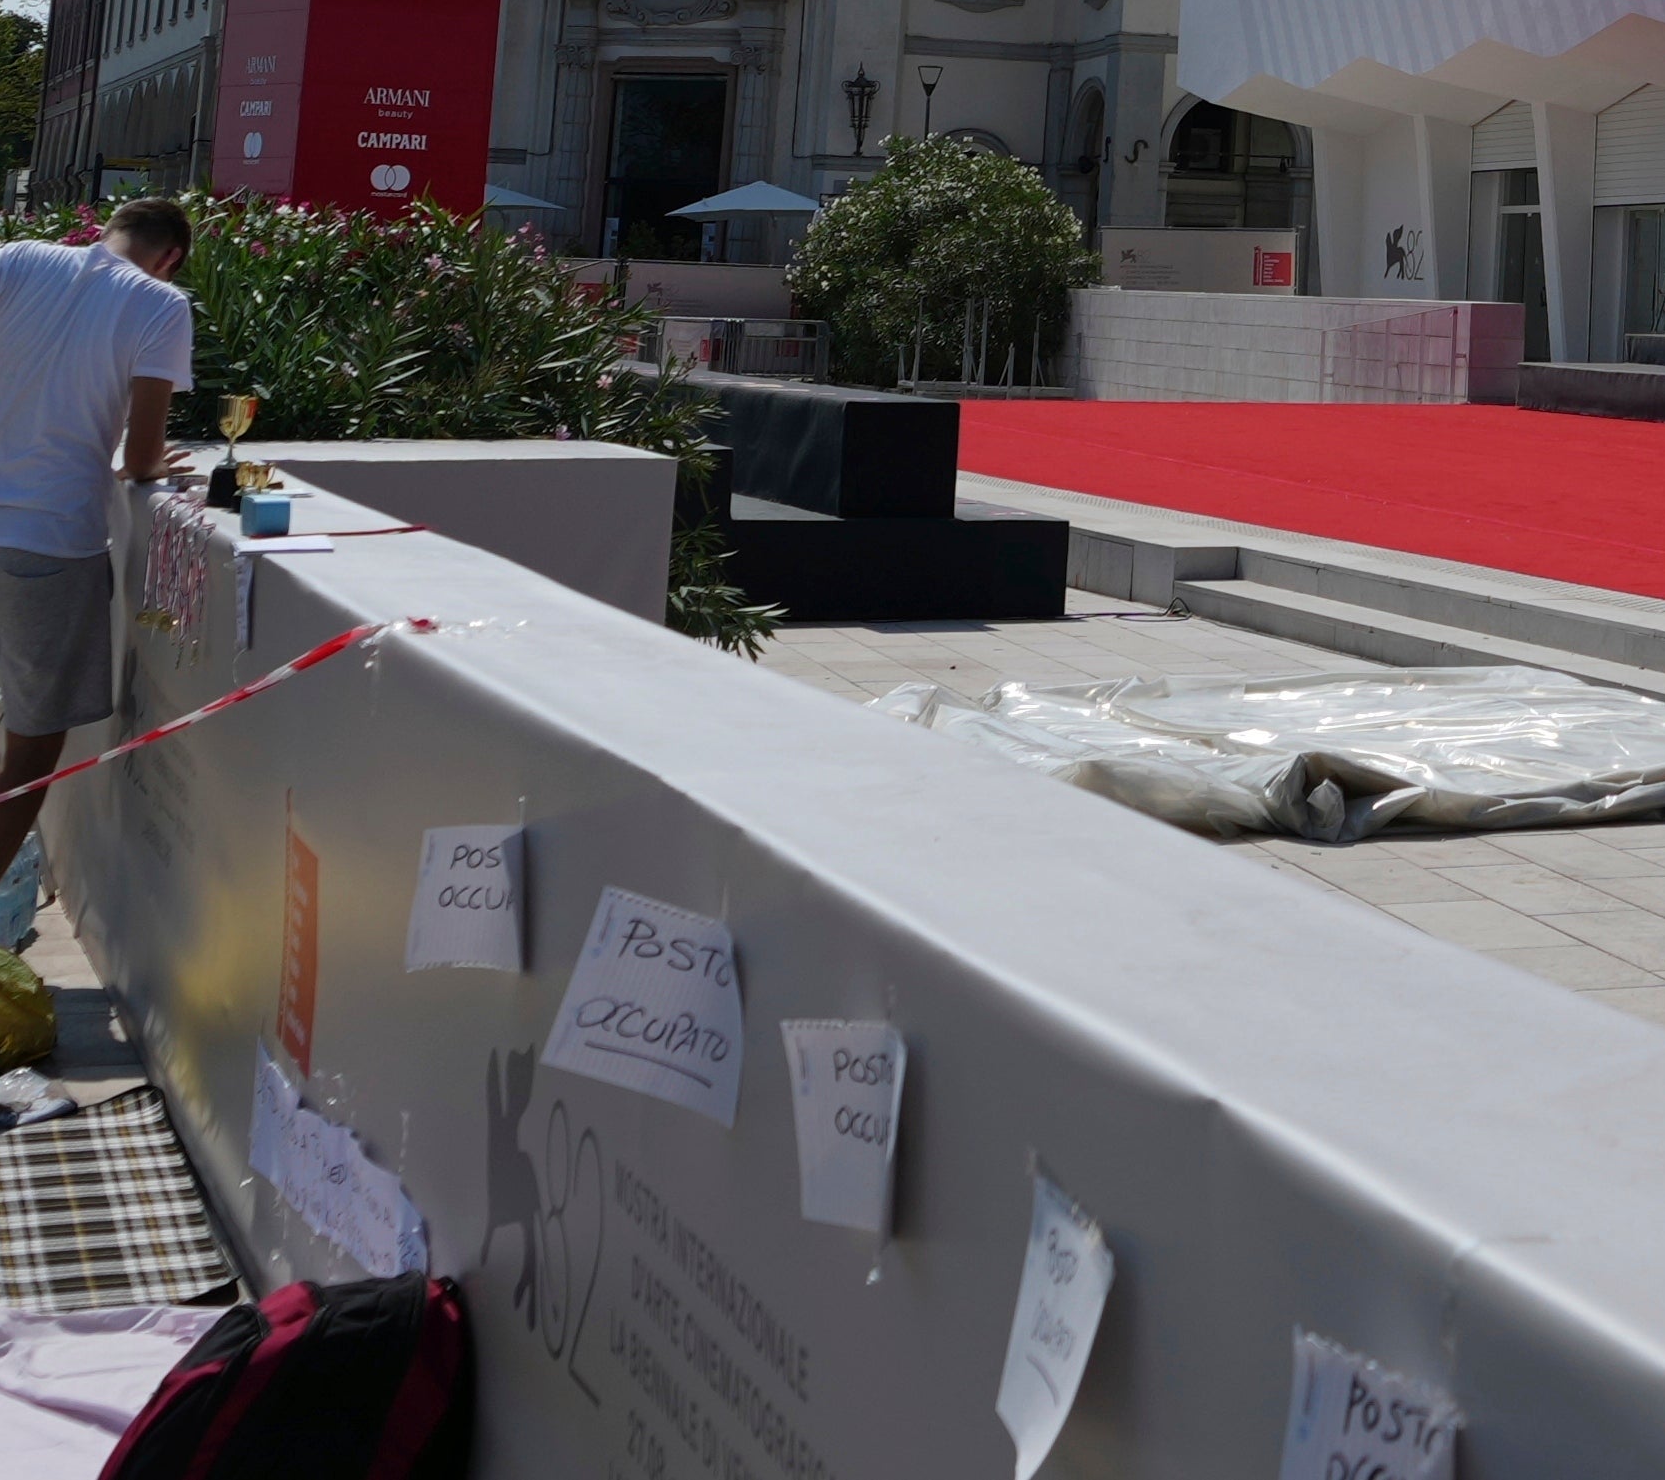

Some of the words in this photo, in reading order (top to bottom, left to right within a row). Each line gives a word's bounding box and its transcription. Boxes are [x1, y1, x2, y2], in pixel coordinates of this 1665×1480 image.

[364, 87, 430, 107] ARMANI
[240, 100, 273, 117] CAMPARI
[378, 109, 413, 119] beauty
[357, 131, 428, 150] CAMPARI
[540, 1099, 602, 1408] 82
[615, 1158, 669, 1255] MOSTRA
[672, 1215, 810, 1404] INTERNAZIONALE
[609, 1307, 626, 1366] LA
[629, 1331, 700, 1452] BIENNALE
